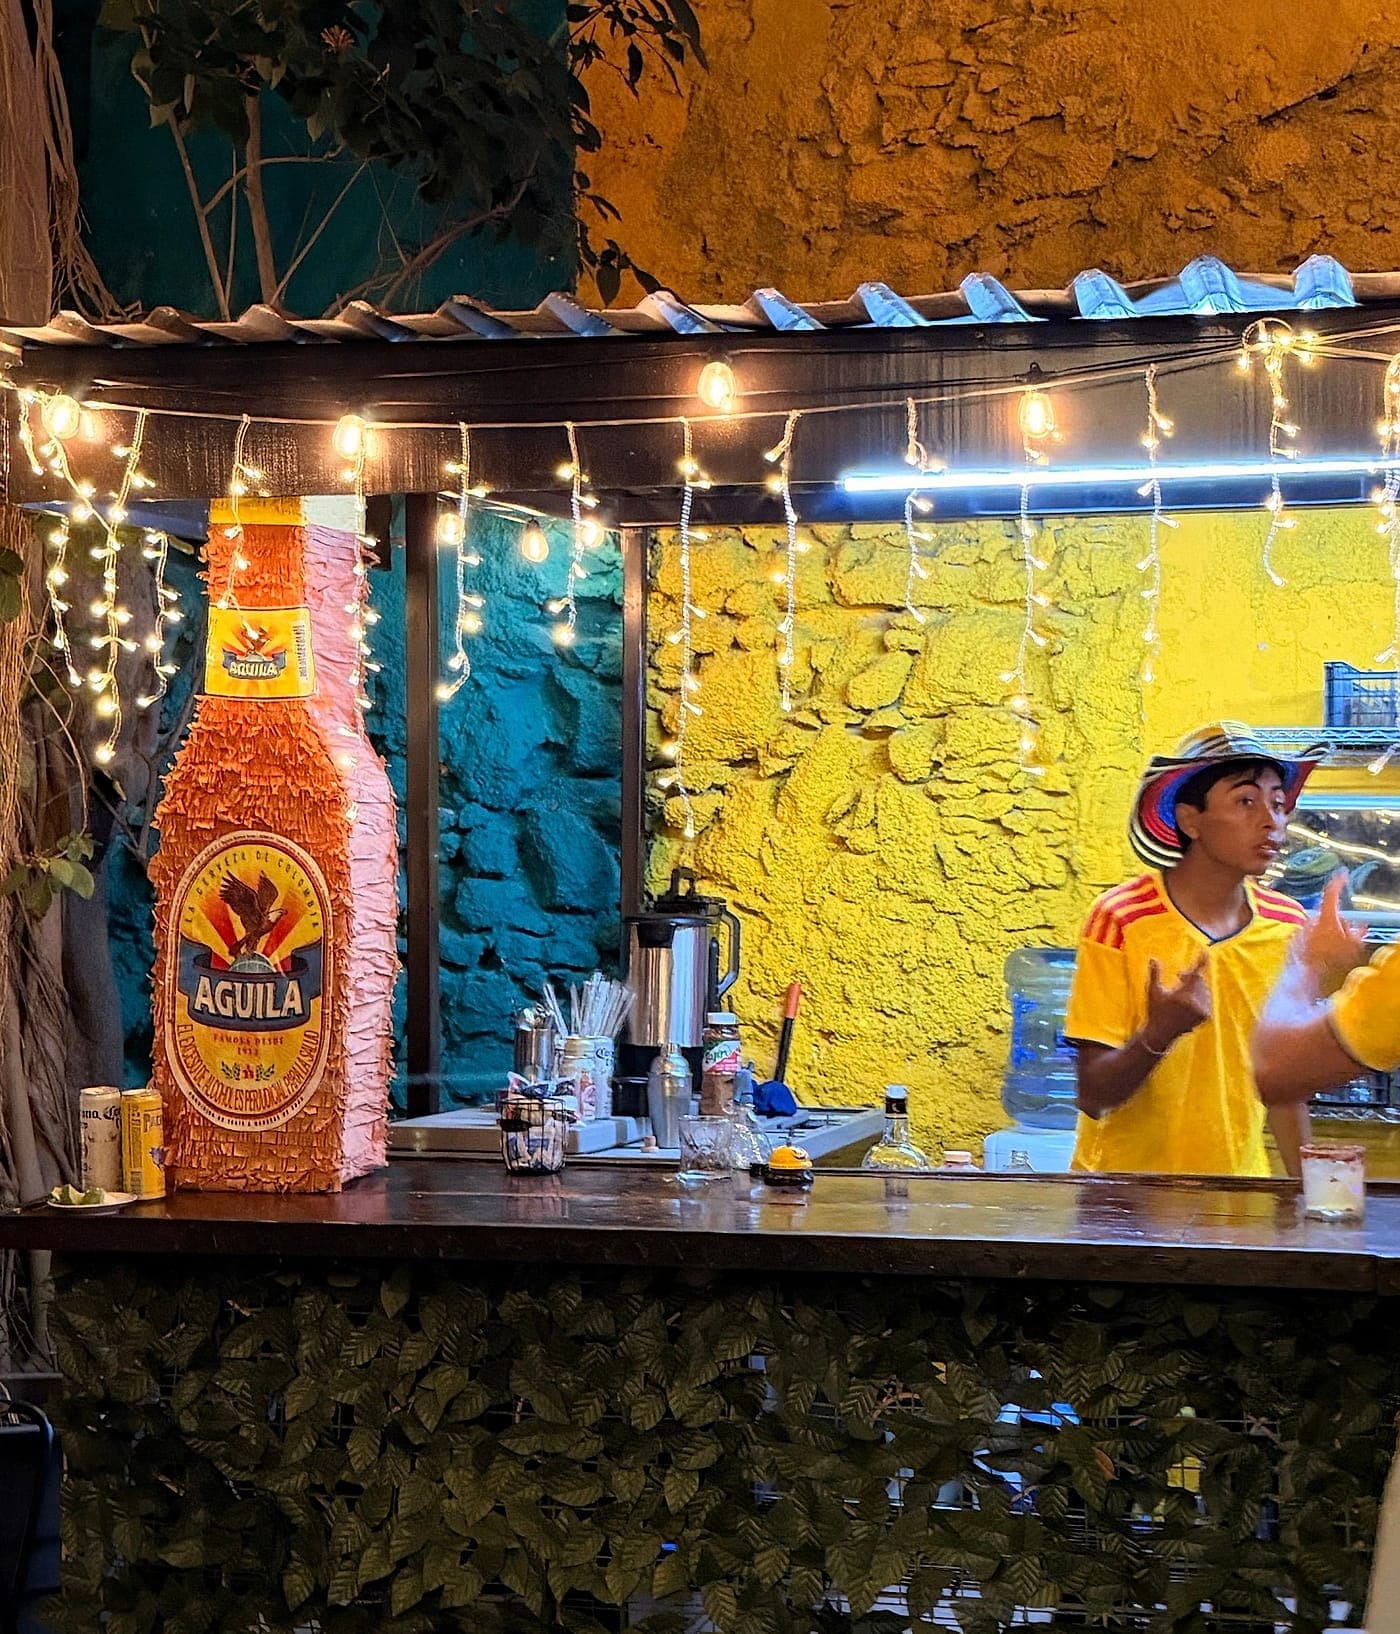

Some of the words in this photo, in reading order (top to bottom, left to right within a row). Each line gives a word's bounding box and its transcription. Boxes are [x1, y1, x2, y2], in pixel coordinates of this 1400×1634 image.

[229, 661, 277, 677] AGUILA
[256, 850, 269, 863] DE
[194, 975, 303, 1018] AGUILA
